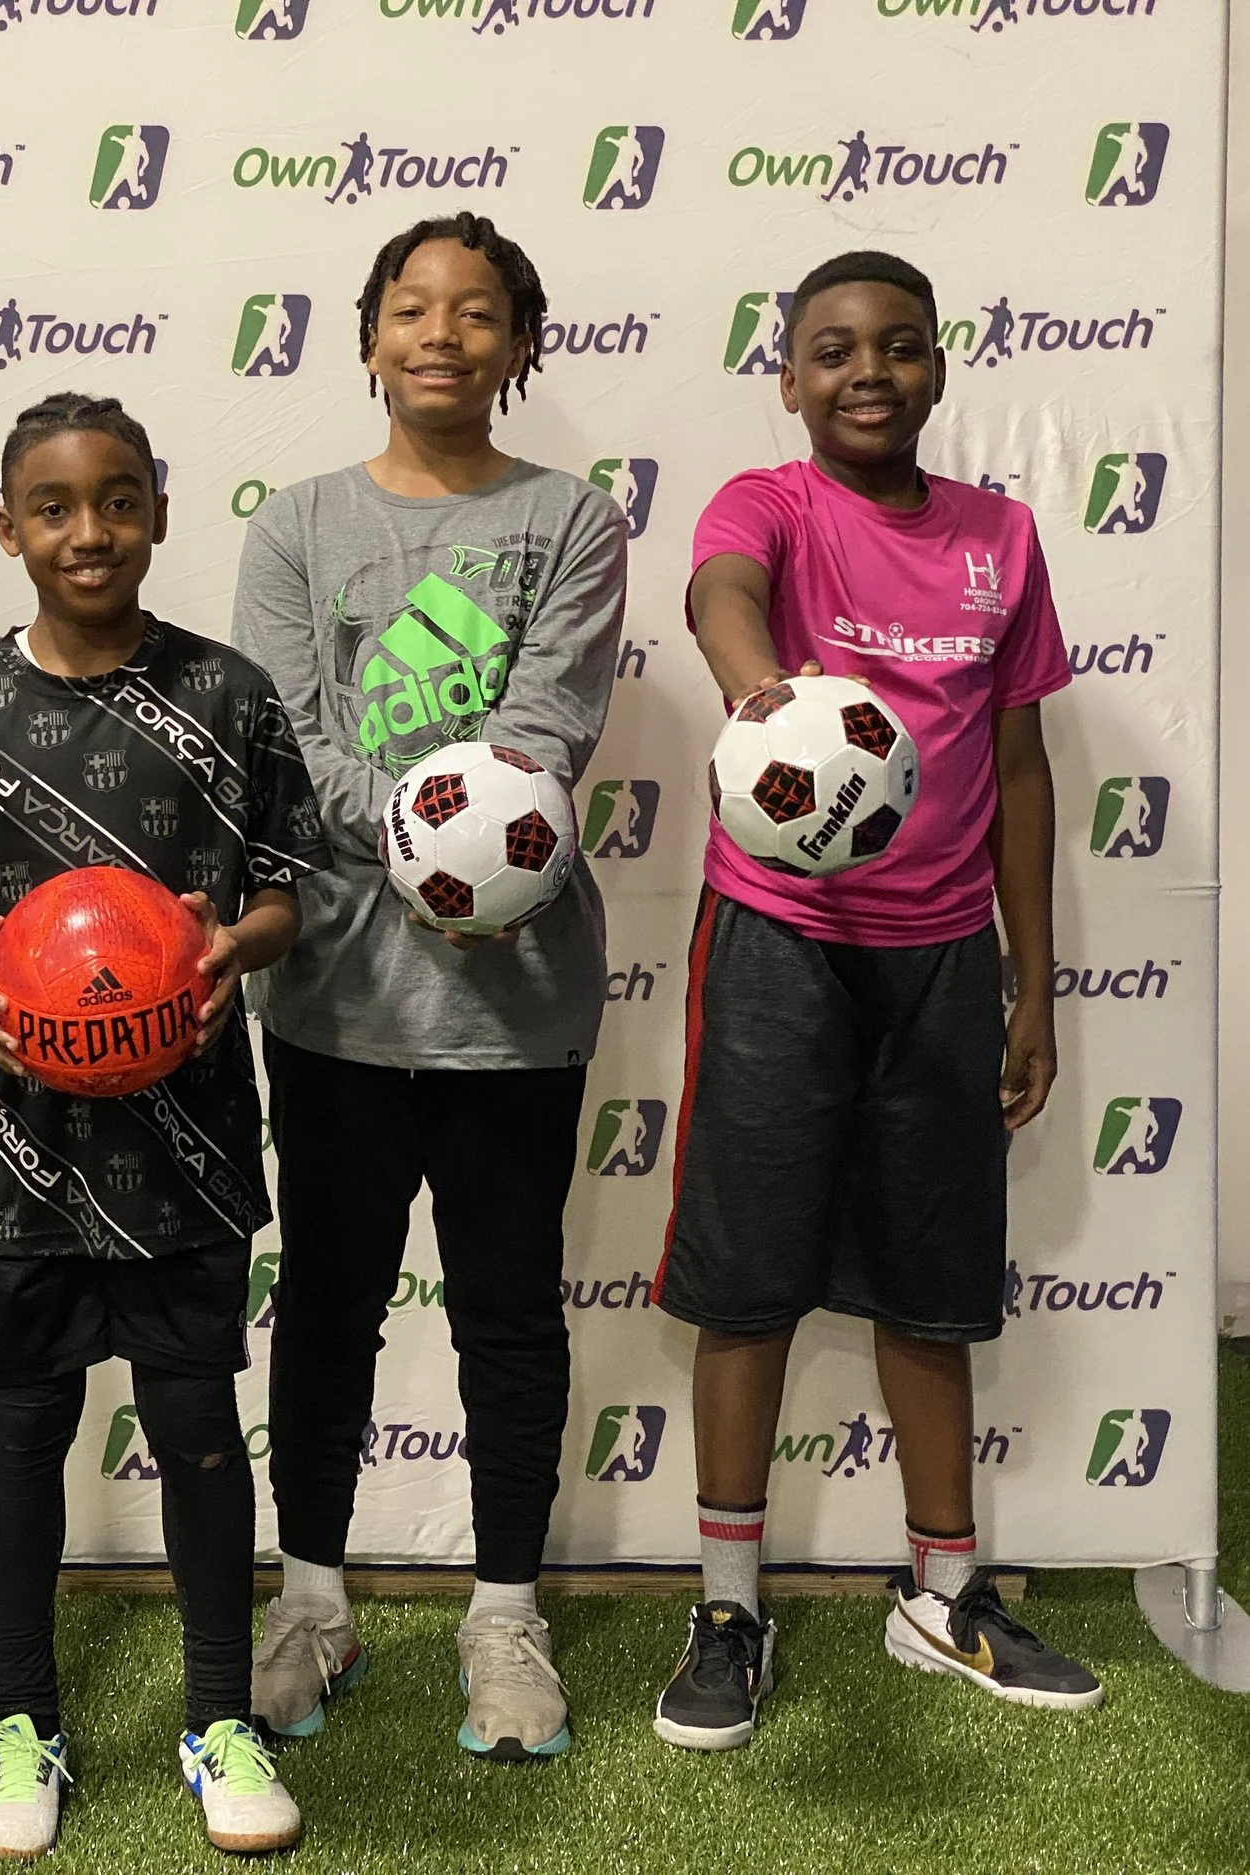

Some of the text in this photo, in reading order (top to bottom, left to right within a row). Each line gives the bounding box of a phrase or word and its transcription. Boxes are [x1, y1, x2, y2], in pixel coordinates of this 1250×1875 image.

[233, 147, 335, 189] Own
[728, 146, 833, 188] Own
[359, 656, 508, 751] adida
[113, 684, 217, 783] FORÇA
[77, 989, 133, 1007] adidas
[18, 988, 200, 1066] PREDATOR
[561, 1271, 653, 1309] uch
[382, 1424, 467, 1461] Tou
[770, 1433, 835, 1463] wn
